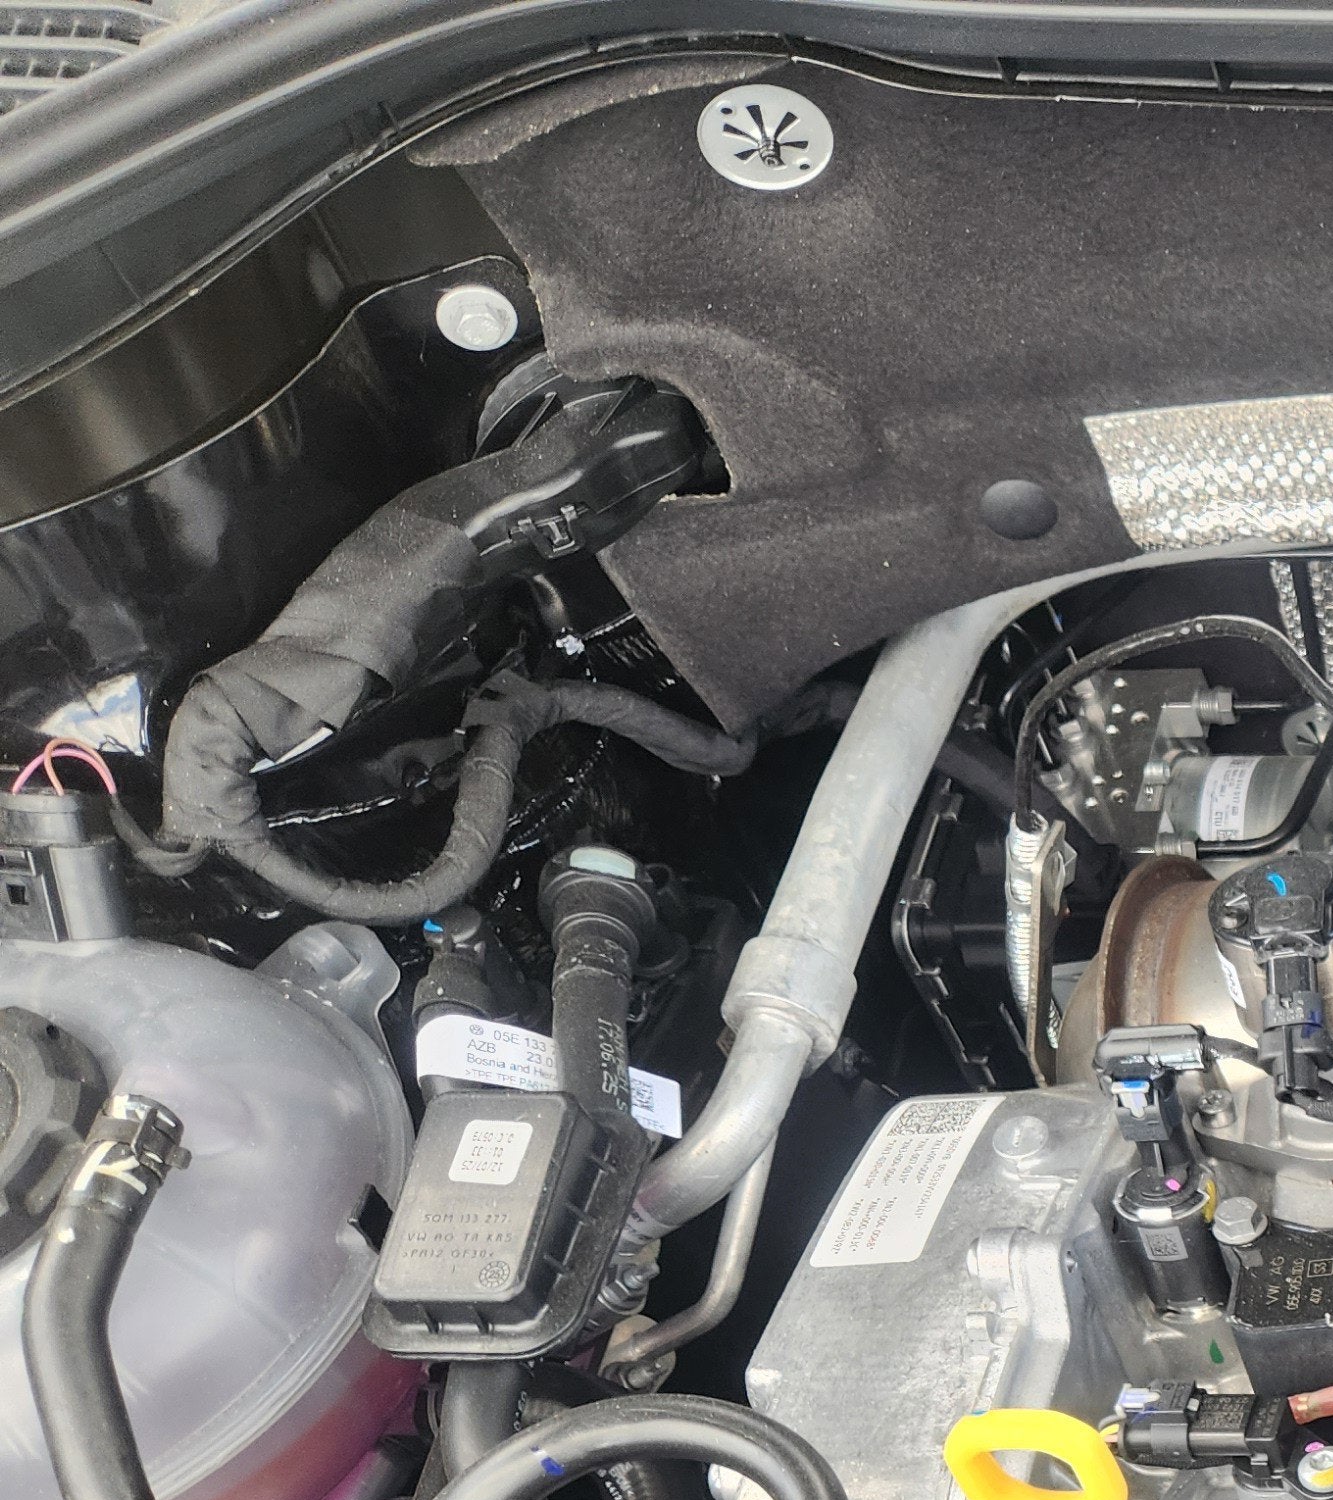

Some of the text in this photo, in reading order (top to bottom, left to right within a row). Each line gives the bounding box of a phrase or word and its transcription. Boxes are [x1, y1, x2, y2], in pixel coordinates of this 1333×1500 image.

[467, 1039, 555, 1068] AZB 23.0
[493, 1031, 546, 1052] 05E 133
[466, 1052, 505, 1070] Bosnia
[509, 1060, 530, 1074] and
[598, 1017, 618, 1096] 17.06.25
[460, 1213, 479, 1224] 133
[1266, 1256, 1285, 1306] VW AG
